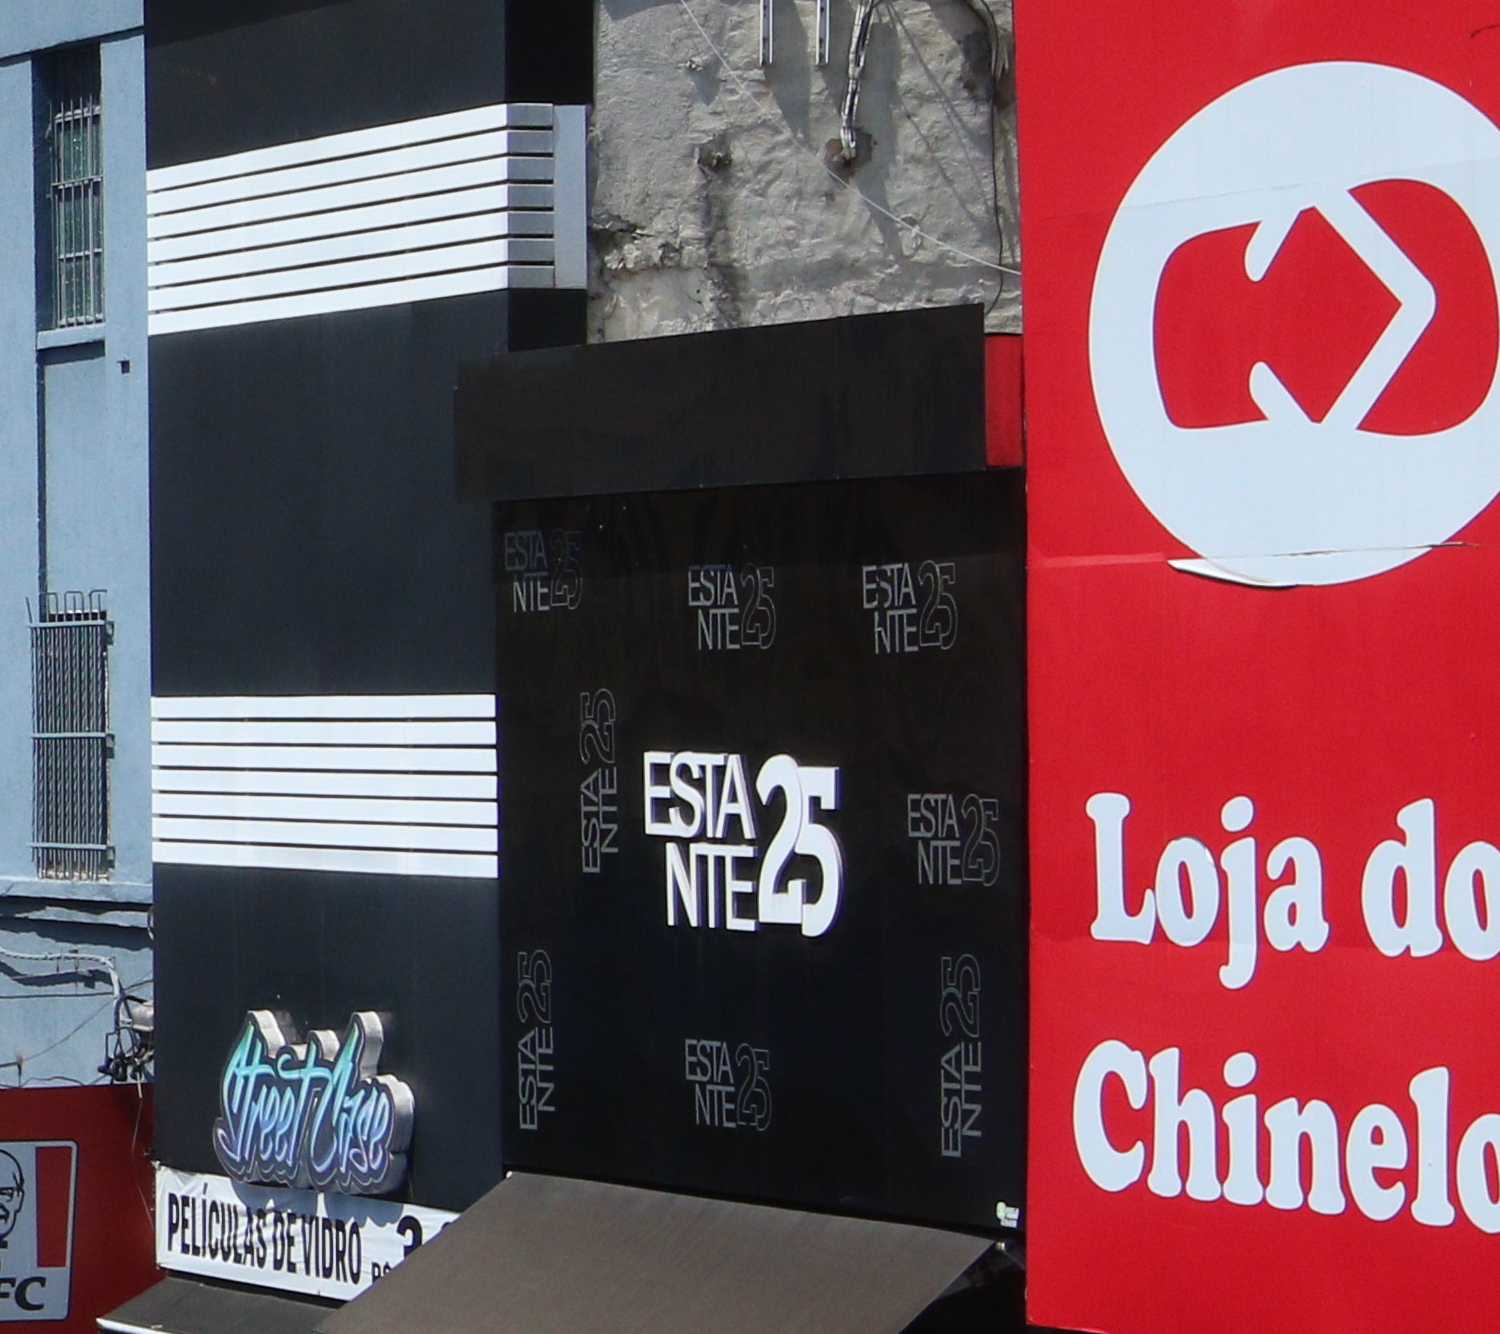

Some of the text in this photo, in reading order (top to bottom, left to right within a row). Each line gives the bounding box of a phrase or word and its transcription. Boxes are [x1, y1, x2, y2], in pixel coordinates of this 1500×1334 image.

[687, 564, 739, 607] ESTA
[696, 605, 741, 650] NTE
[738, 561, 777, 649] 25
[862, 563, 916, 608] ESTA
[873, 606, 920, 653] NTE
[916, 559, 959, 650] 25
[642, 748, 756, 839] ESTA
[664, 840, 760, 933] NTE
[754, 751, 843, 938] 25
[1084, 791, 1330, 990] Loja
[167, 1183, 267, 1271] PELÍCULAS
[271, 1209, 297, 1274] DE
[300, 1214, 362, 1286] VIDRO
